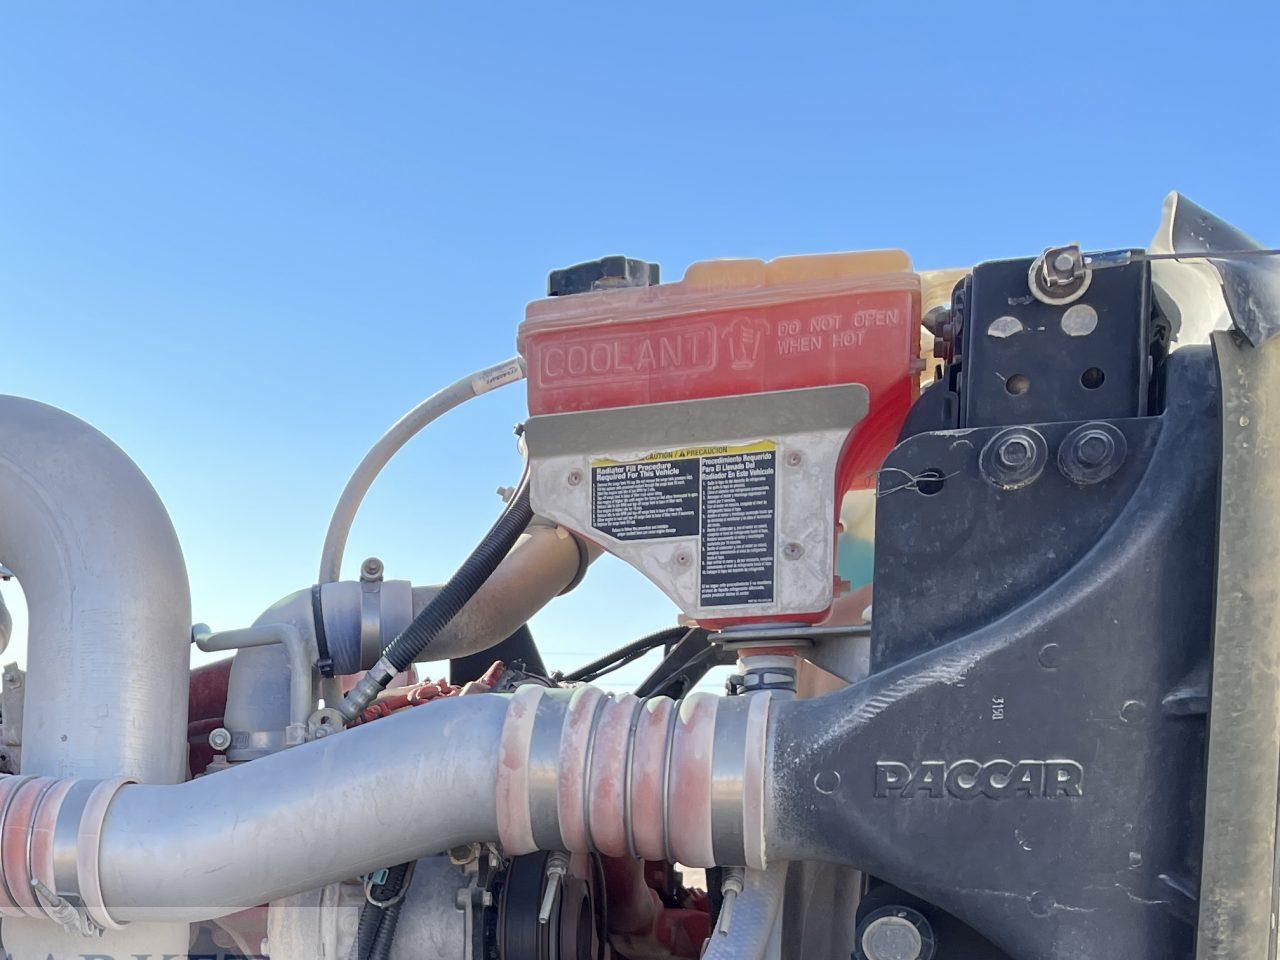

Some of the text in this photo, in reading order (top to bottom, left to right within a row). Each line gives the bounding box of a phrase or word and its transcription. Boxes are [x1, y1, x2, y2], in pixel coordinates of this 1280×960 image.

[778, 310, 898, 336] DO NOT OPEN
[543, 331, 705, 377] COOLANT
[777, 330, 866, 354] WHEN HOT
[596, 466, 624, 475] Radiator
[637, 462, 671, 471] Procedure
[596, 468, 680, 482] Required For This Vehicle
[873, 758, 1084, 799] PACCAR
